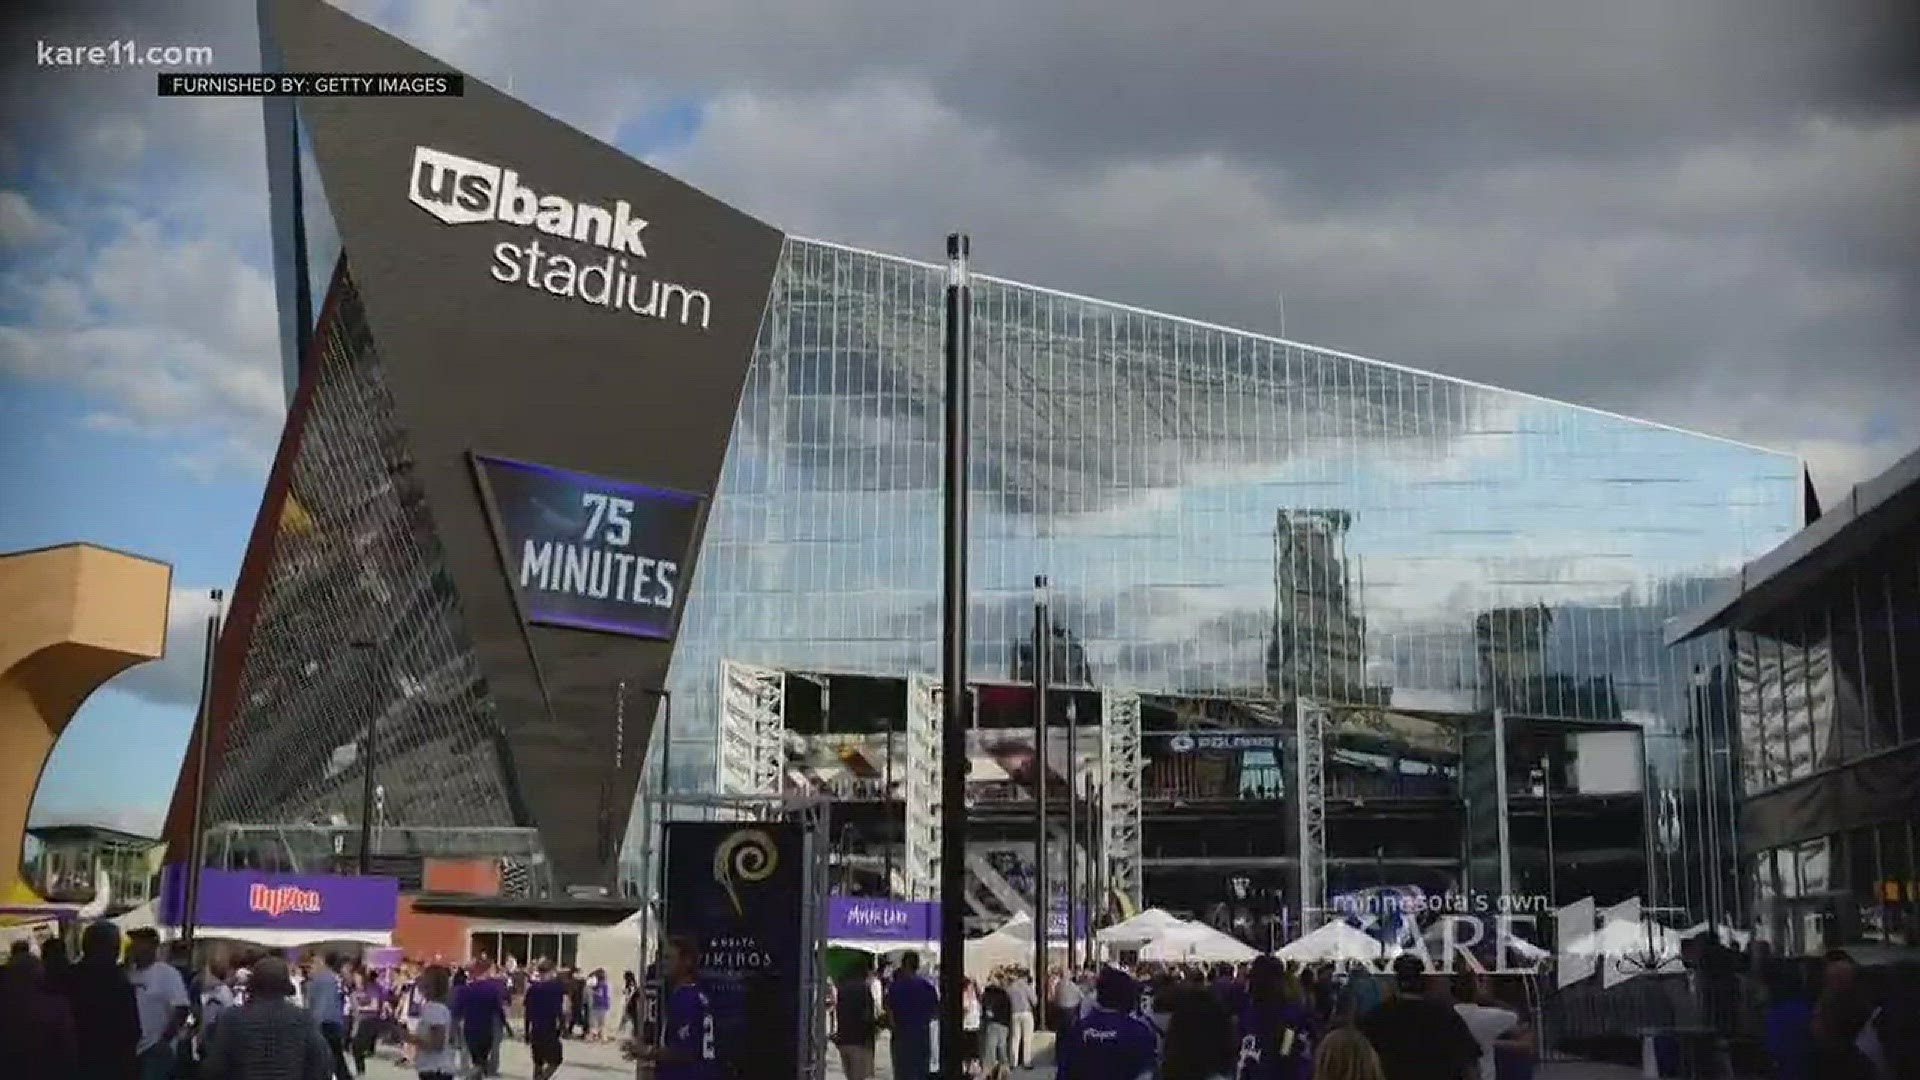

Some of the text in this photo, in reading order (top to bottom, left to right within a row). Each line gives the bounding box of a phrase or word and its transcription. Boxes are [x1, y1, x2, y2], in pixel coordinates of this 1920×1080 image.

[490, 239, 712, 329] stadium
[583, 492, 635, 546] 75
[520, 538, 677, 609] MINUTES
